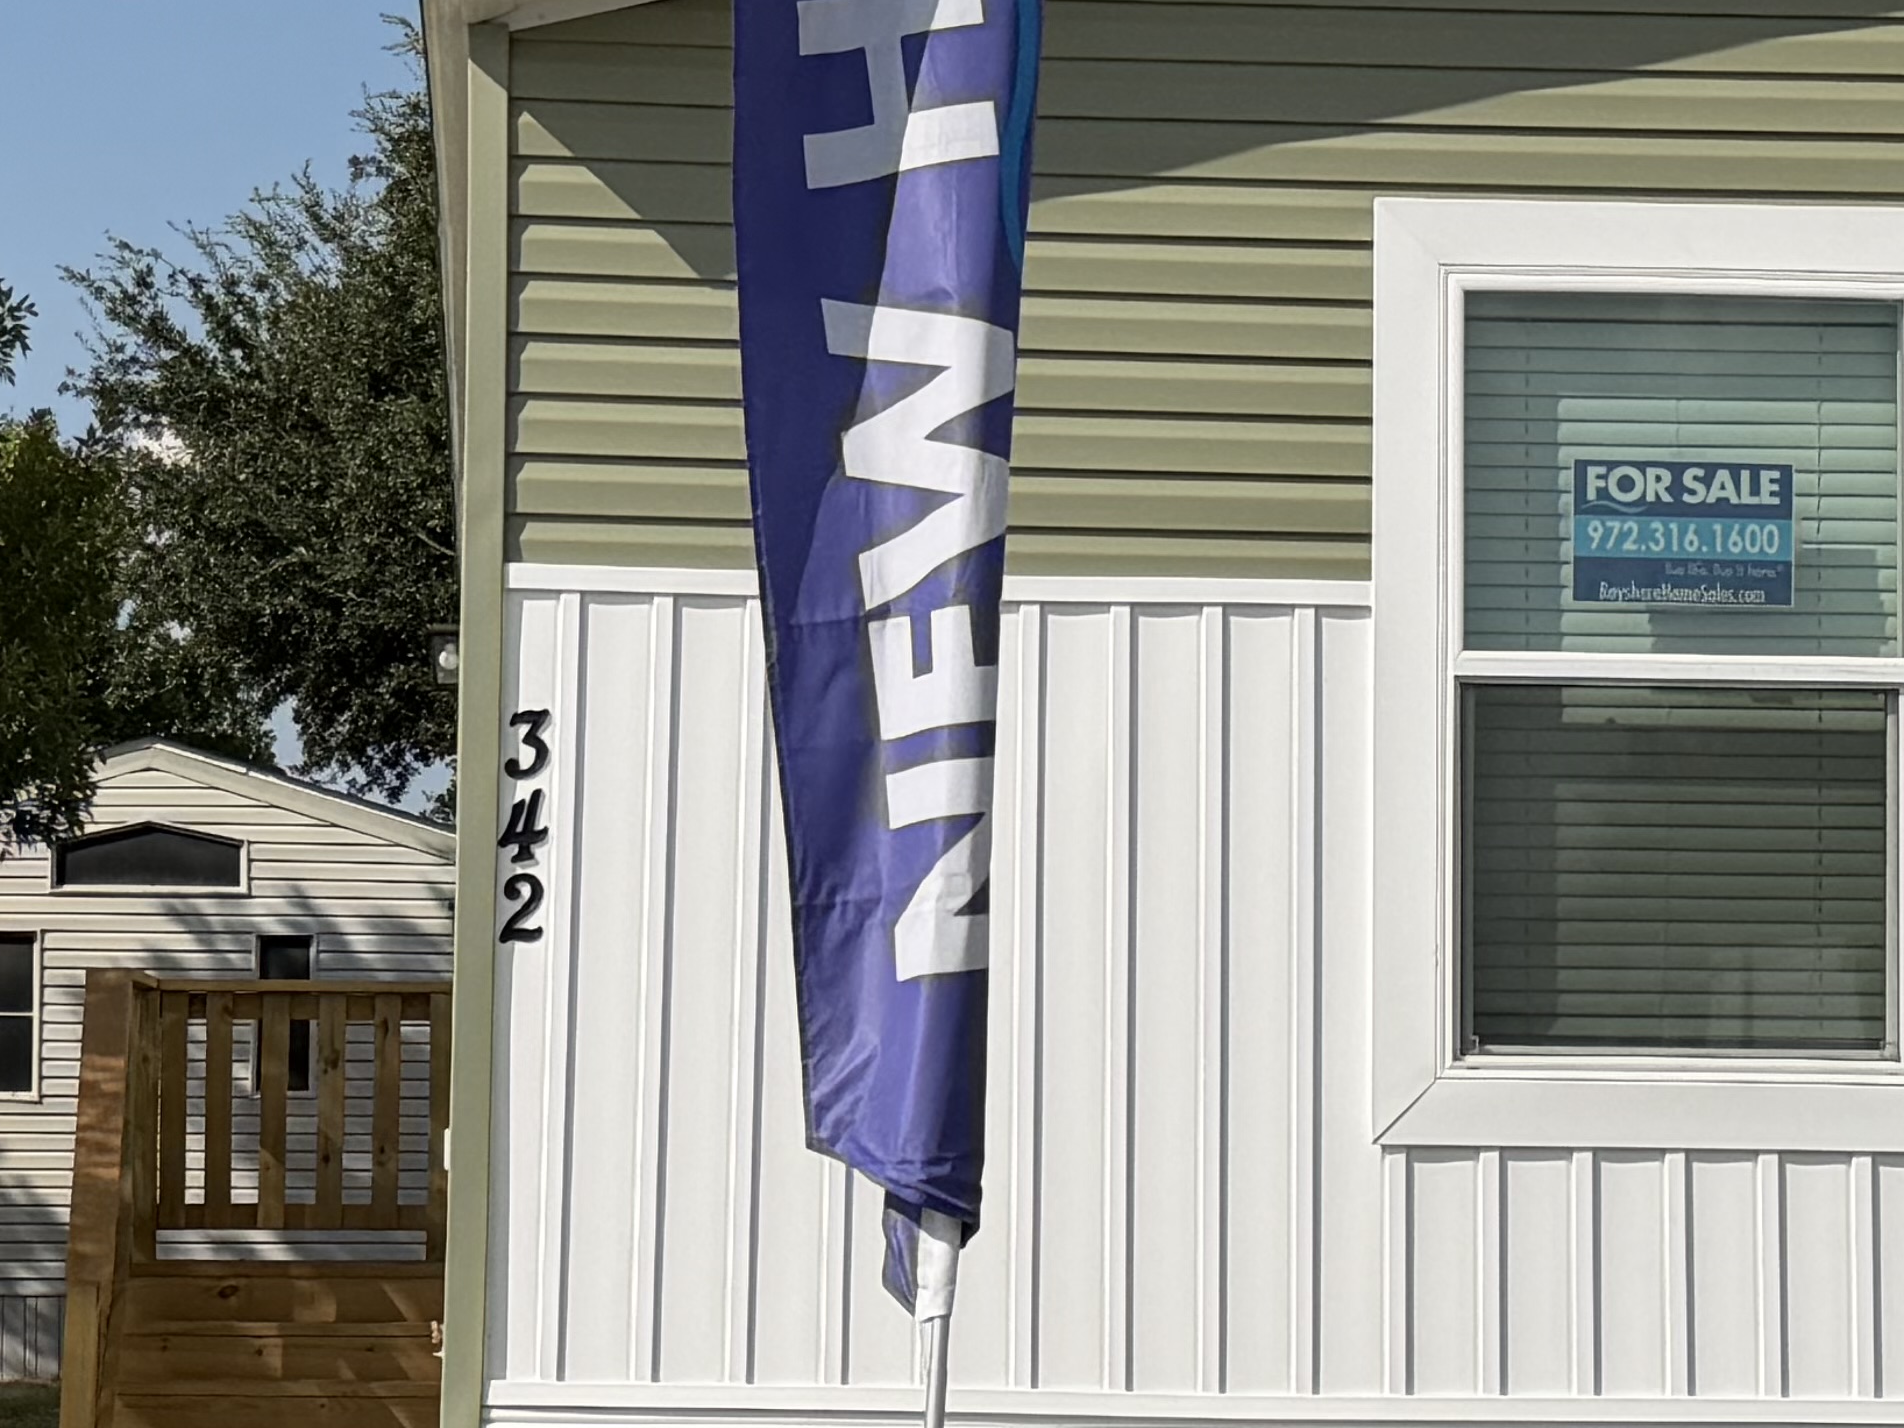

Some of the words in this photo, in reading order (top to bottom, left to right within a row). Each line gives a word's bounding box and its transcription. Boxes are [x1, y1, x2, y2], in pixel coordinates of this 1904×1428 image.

[1585, 465, 1674, 503] FOR
[1682, 468, 1781, 505] SALE
[1587, 520, 1780, 554] 972.316.1600
[820, 296, 1016, 983] NEW
